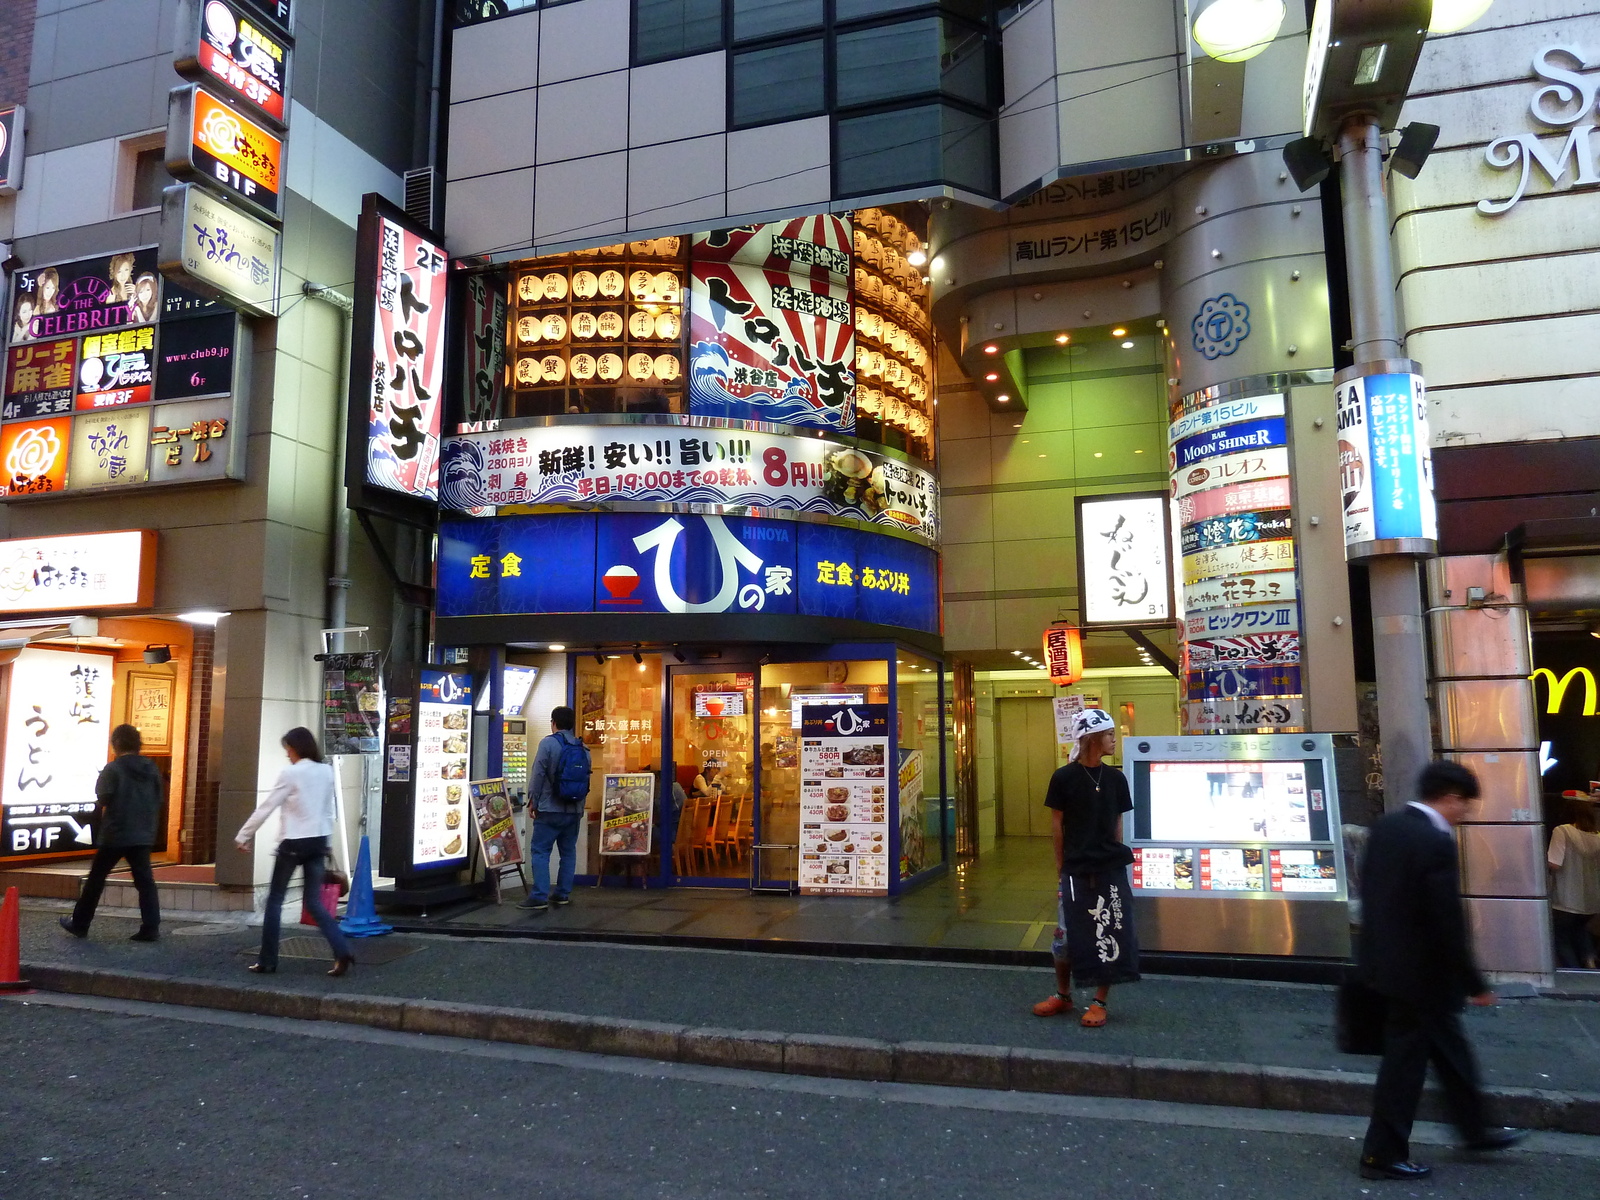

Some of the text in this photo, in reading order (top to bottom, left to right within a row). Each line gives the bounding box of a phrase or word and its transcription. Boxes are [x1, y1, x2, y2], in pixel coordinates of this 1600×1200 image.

[234, 136, 276, 177] はなまる
[216, 161, 256, 196] B1F
[1016, 207, 1171, 261] 高山ランド第15ビル
[188, 258, 199, 269] 2F
[416, 246, 444, 276] 2F
[20, 273, 36, 293] 5F
[57, 278, 112, 309] CLUB
[74, 298, 93, 309] THE
[167, 300, 200, 312] NINE
[29, 304, 137, 337] CELEBRITY
[15, 341, 73, 366] リーチ
[166, 347, 229, 363] www.club9.jp
[389, 272, 431, 461] トロハチ
[12, 362, 72, 394] 麻雀
[190, 372, 206, 387] 6F
[734, 367, 778, 388] 渋谷店
[1347, 385, 1359, 405] A
[3, 401, 21, 418] 4F
[36, 399, 71, 414] 大安
[151, 418, 229, 445] ニュー渋谷
[1170, 402, 1258, 440] 高山ランド第15ビル
[1211, 430, 1227, 440] BAR
[166, 443, 212, 466] ビル
[488, 437, 529, 457] 浜焼き
[538, 438, 751, 476] 新鮮! 安い!! 旨い!!!
[487, 456, 533, 470] 280円ヨリ
[762, 447, 824, 488] 8円!!
[1211, 458, 1267, 479] コレオス
[10, 472, 53, 494] はなまる
[487, 471, 529, 490] 刺身
[915, 473, 925, 491] 2F
[486, 489, 533, 503] 580円ヨリ
[742, 526, 789, 542] HINOYA
[1240, 543, 1292, 563] 健美園
[469, 552, 523, 579] 定食
[632, 516, 793, 613] ひの家
[33, 562, 88, 590] はなまる
[1221, 578, 1281, 601] 花子っ子
[1047, 630, 1070, 677] 居酒屋
[584, 719, 652, 731] ご飯大盛無料
[832, 707, 871, 736] ひの家
[18, 704, 52, 792] うどん
[598, 733, 652, 744] サービス中
[702, 750, 728, 758] OPEN
[480, 783, 503, 794] NEW!
[618, 777, 650, 787] NEW!
[13, 827, 61, 851] B1F
